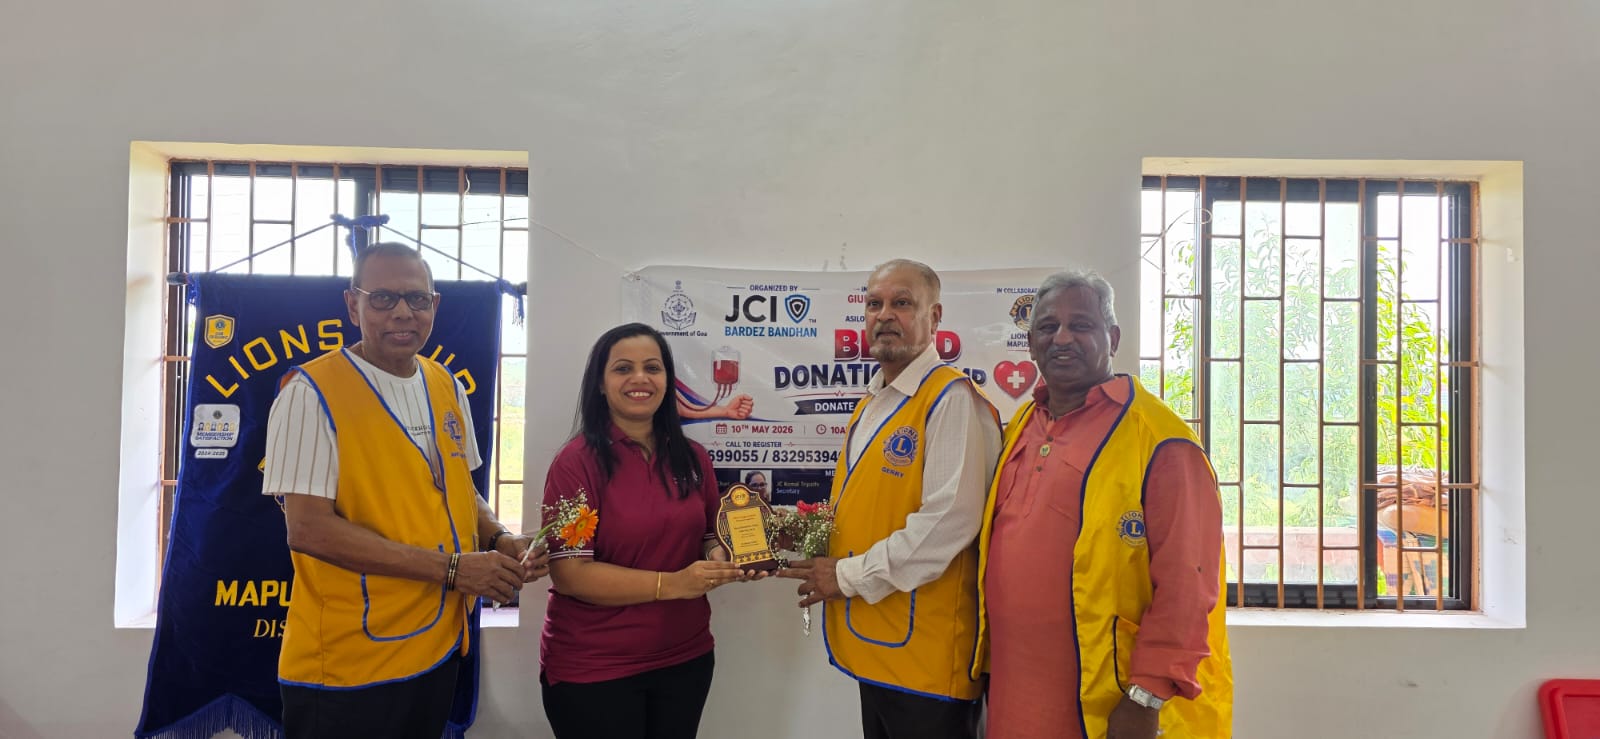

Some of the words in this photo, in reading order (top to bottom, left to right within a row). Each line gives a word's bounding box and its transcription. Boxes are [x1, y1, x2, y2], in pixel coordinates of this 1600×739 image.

[749, 284, 788, 292] ORGANIZED
[847, 294, 866, 304] GIU
[725, 294, 778, 323] JCI
[724, 325, 766, 337] BARDEZ
[768, 326, 818, 338] BANDHAN
[206, 318, 345, 398] LIONS
[814, 401, 855, 412] DONATE
[731, 424, 749, 434] 10TH
[751, 425, 770, 434] MAY
[771, 425, 794, 434] 2026
[830, 426, 847, 434] 10A
[895, 437, 907, 454] L
[708, 449, 759, 462] 699055
[762, 449, 769, 463] /
[772, 449, 841, 463] 83295394
[1130, 521, 1141, 535] L
